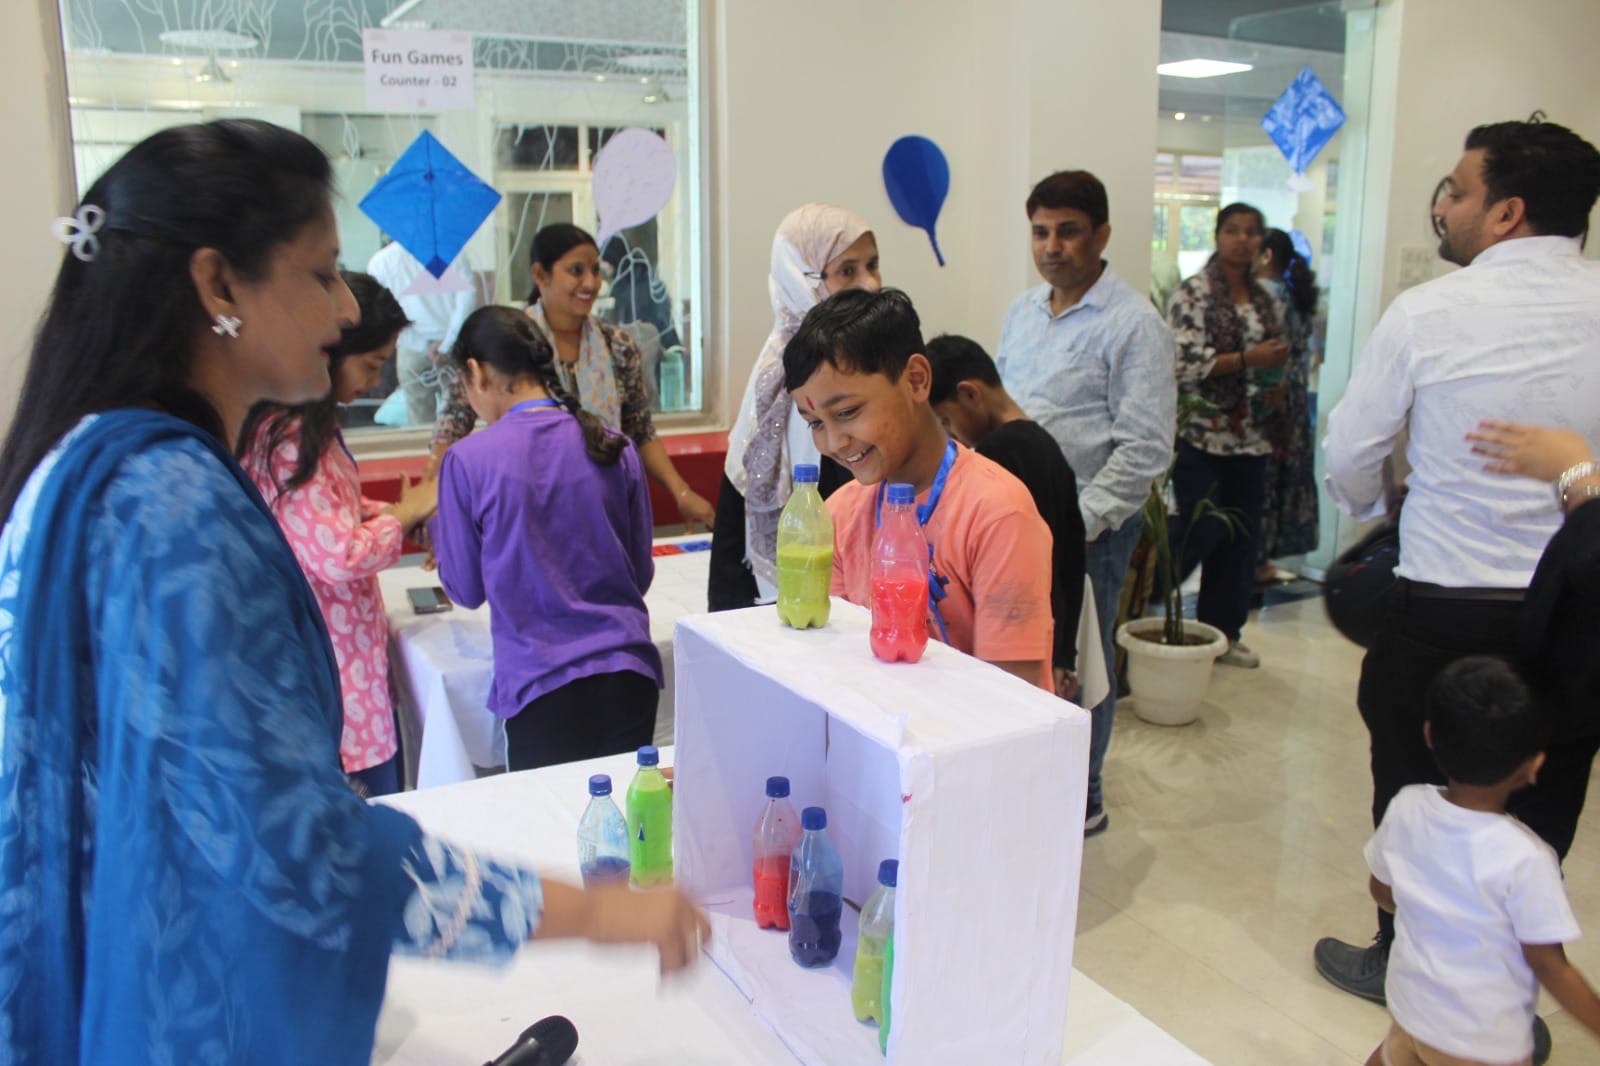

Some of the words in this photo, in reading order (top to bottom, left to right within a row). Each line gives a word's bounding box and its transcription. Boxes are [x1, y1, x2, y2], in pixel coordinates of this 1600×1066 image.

[371, 48, 402, 64] Fun
[407, 49, 464, 66] Games
[380, 74, 431, 87] Counter
[441, 75, 457, 87] 02
